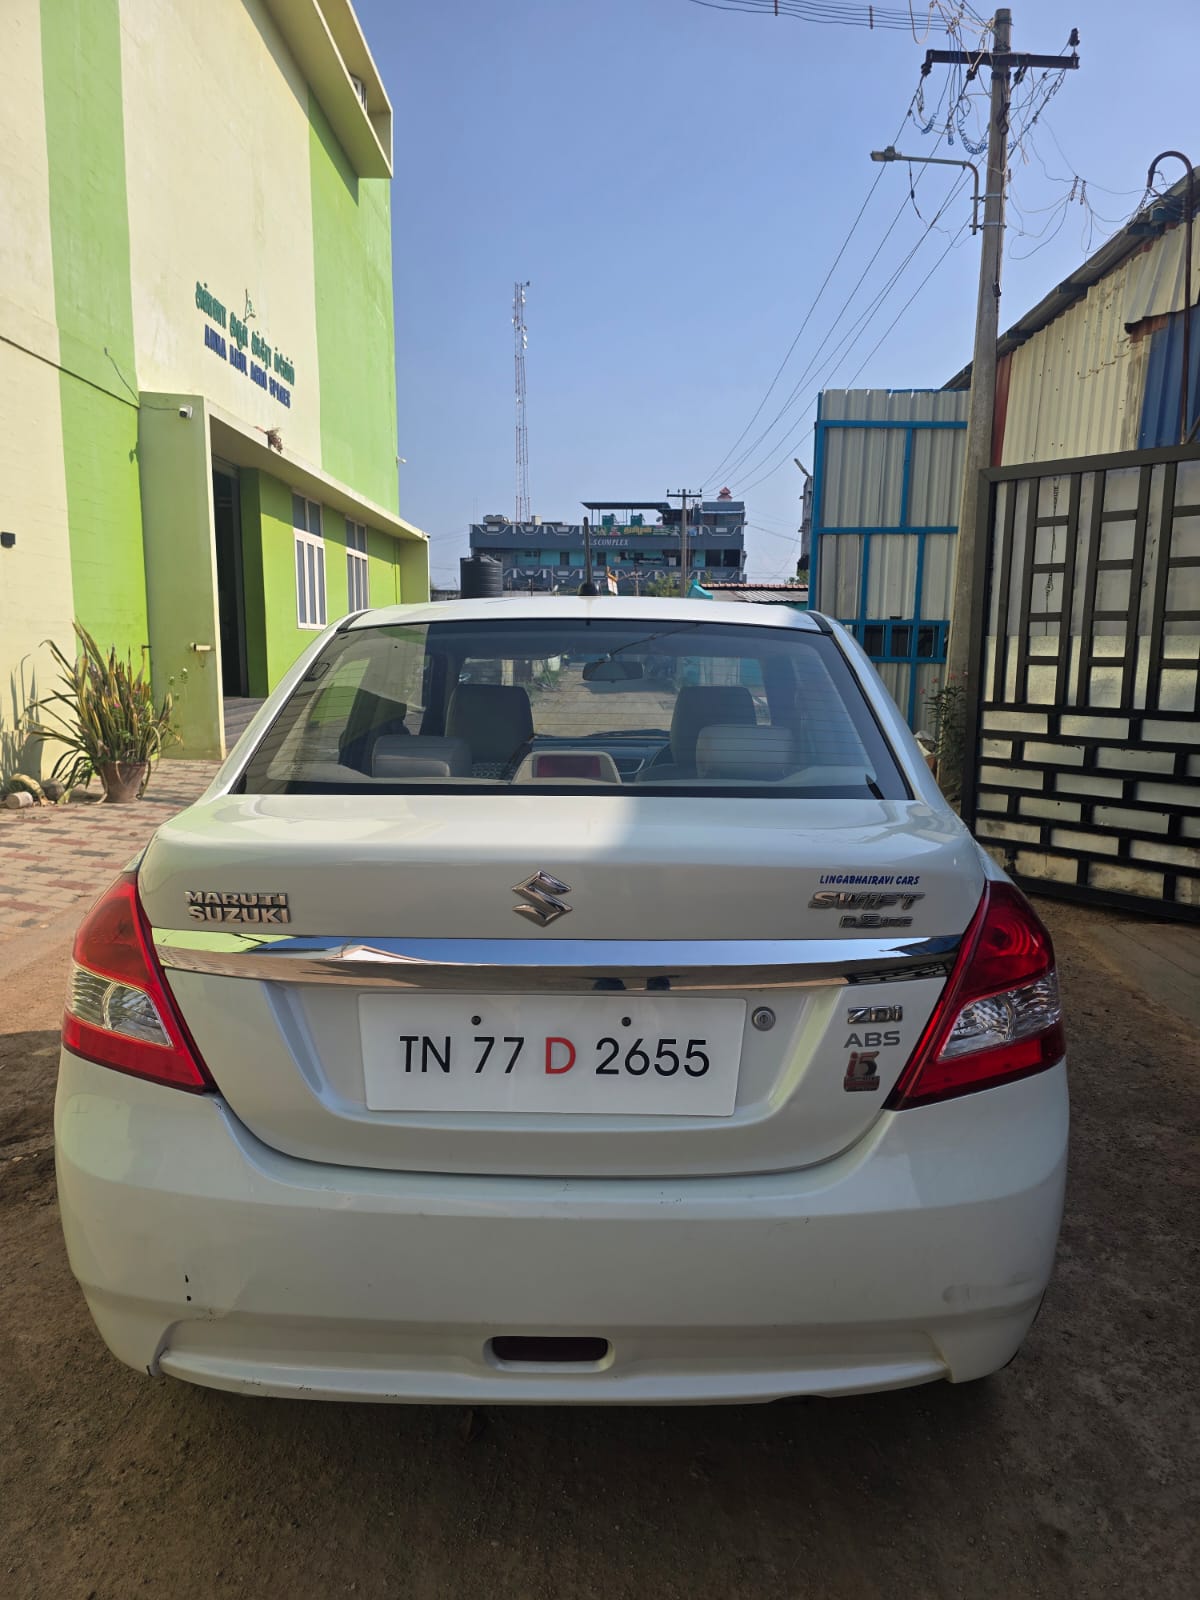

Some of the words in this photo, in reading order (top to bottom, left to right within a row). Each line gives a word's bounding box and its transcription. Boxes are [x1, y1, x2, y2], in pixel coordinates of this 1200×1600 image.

[820, 875, 894, 885] LINGABHAIRAVI
[896, 876, 920, 886] CARS
[184, 891, 288, 906] MARUTI
[808, 891, 925, 910] SWIFT
[188, 906, 291, 923] SUZUKI
[844, 1031, 901, 1048] ABS
[400, 1036, 451, 1073] TN
[473, 1036, 525, 1074] 77
[545, 1037, 577, 1075] D
[595, 1037, 710, 1077] 2655
